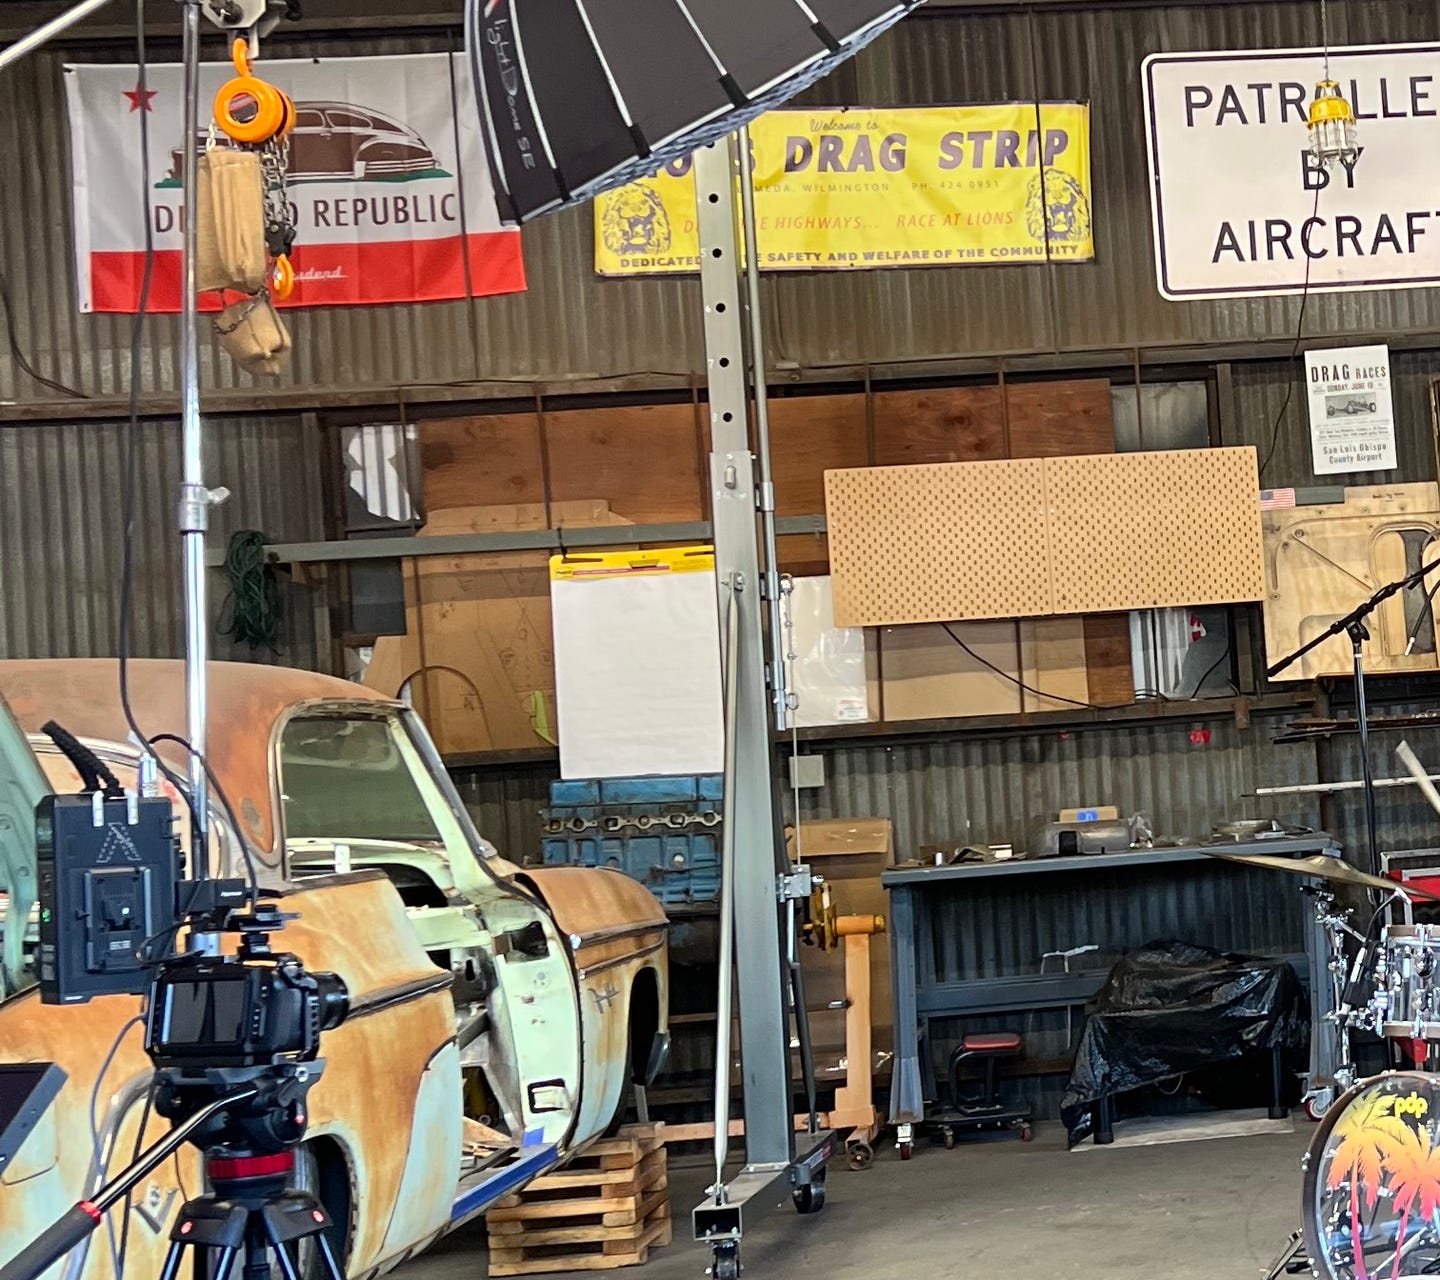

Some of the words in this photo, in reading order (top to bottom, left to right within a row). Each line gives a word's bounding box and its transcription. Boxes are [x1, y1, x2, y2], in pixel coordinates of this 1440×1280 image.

[785, 132, 907, 173] DRAG
[938, 128, 1068, 169] STRIP
[1301, 146, 1364, 190] BY
[802, 183, 890, 192] WILMINGTON
[313, 193, 457, 228] REPUBLIC
[896, 214, 937, 228] RACE
[943, 213, 960, 227] AT
[967, 211, 1014, 226] LIONS
[768, 252, 821, 262] SAFETY
[828, 250, 858, 262] AND
[863, 248, 930, 261] WELFARE
[933, 249, 953, 259] OF
[958, 247, 986, 258] THE
[990, 244, 1080, 257] COMMUNITY
[1311, 364, 1350, 382] DRAG
[1355, 366, 1387, 380] RACES
[1323, 446, 1338, 455] San
[1340, 444, 1357, 453] Luis
[1359, 443, 1387, 452] Obispo
[1329, 455, 1354, 464] County
[1357, 453, 1382, 462] Airport
[1394, 1091, 1428, 1119] pdp
